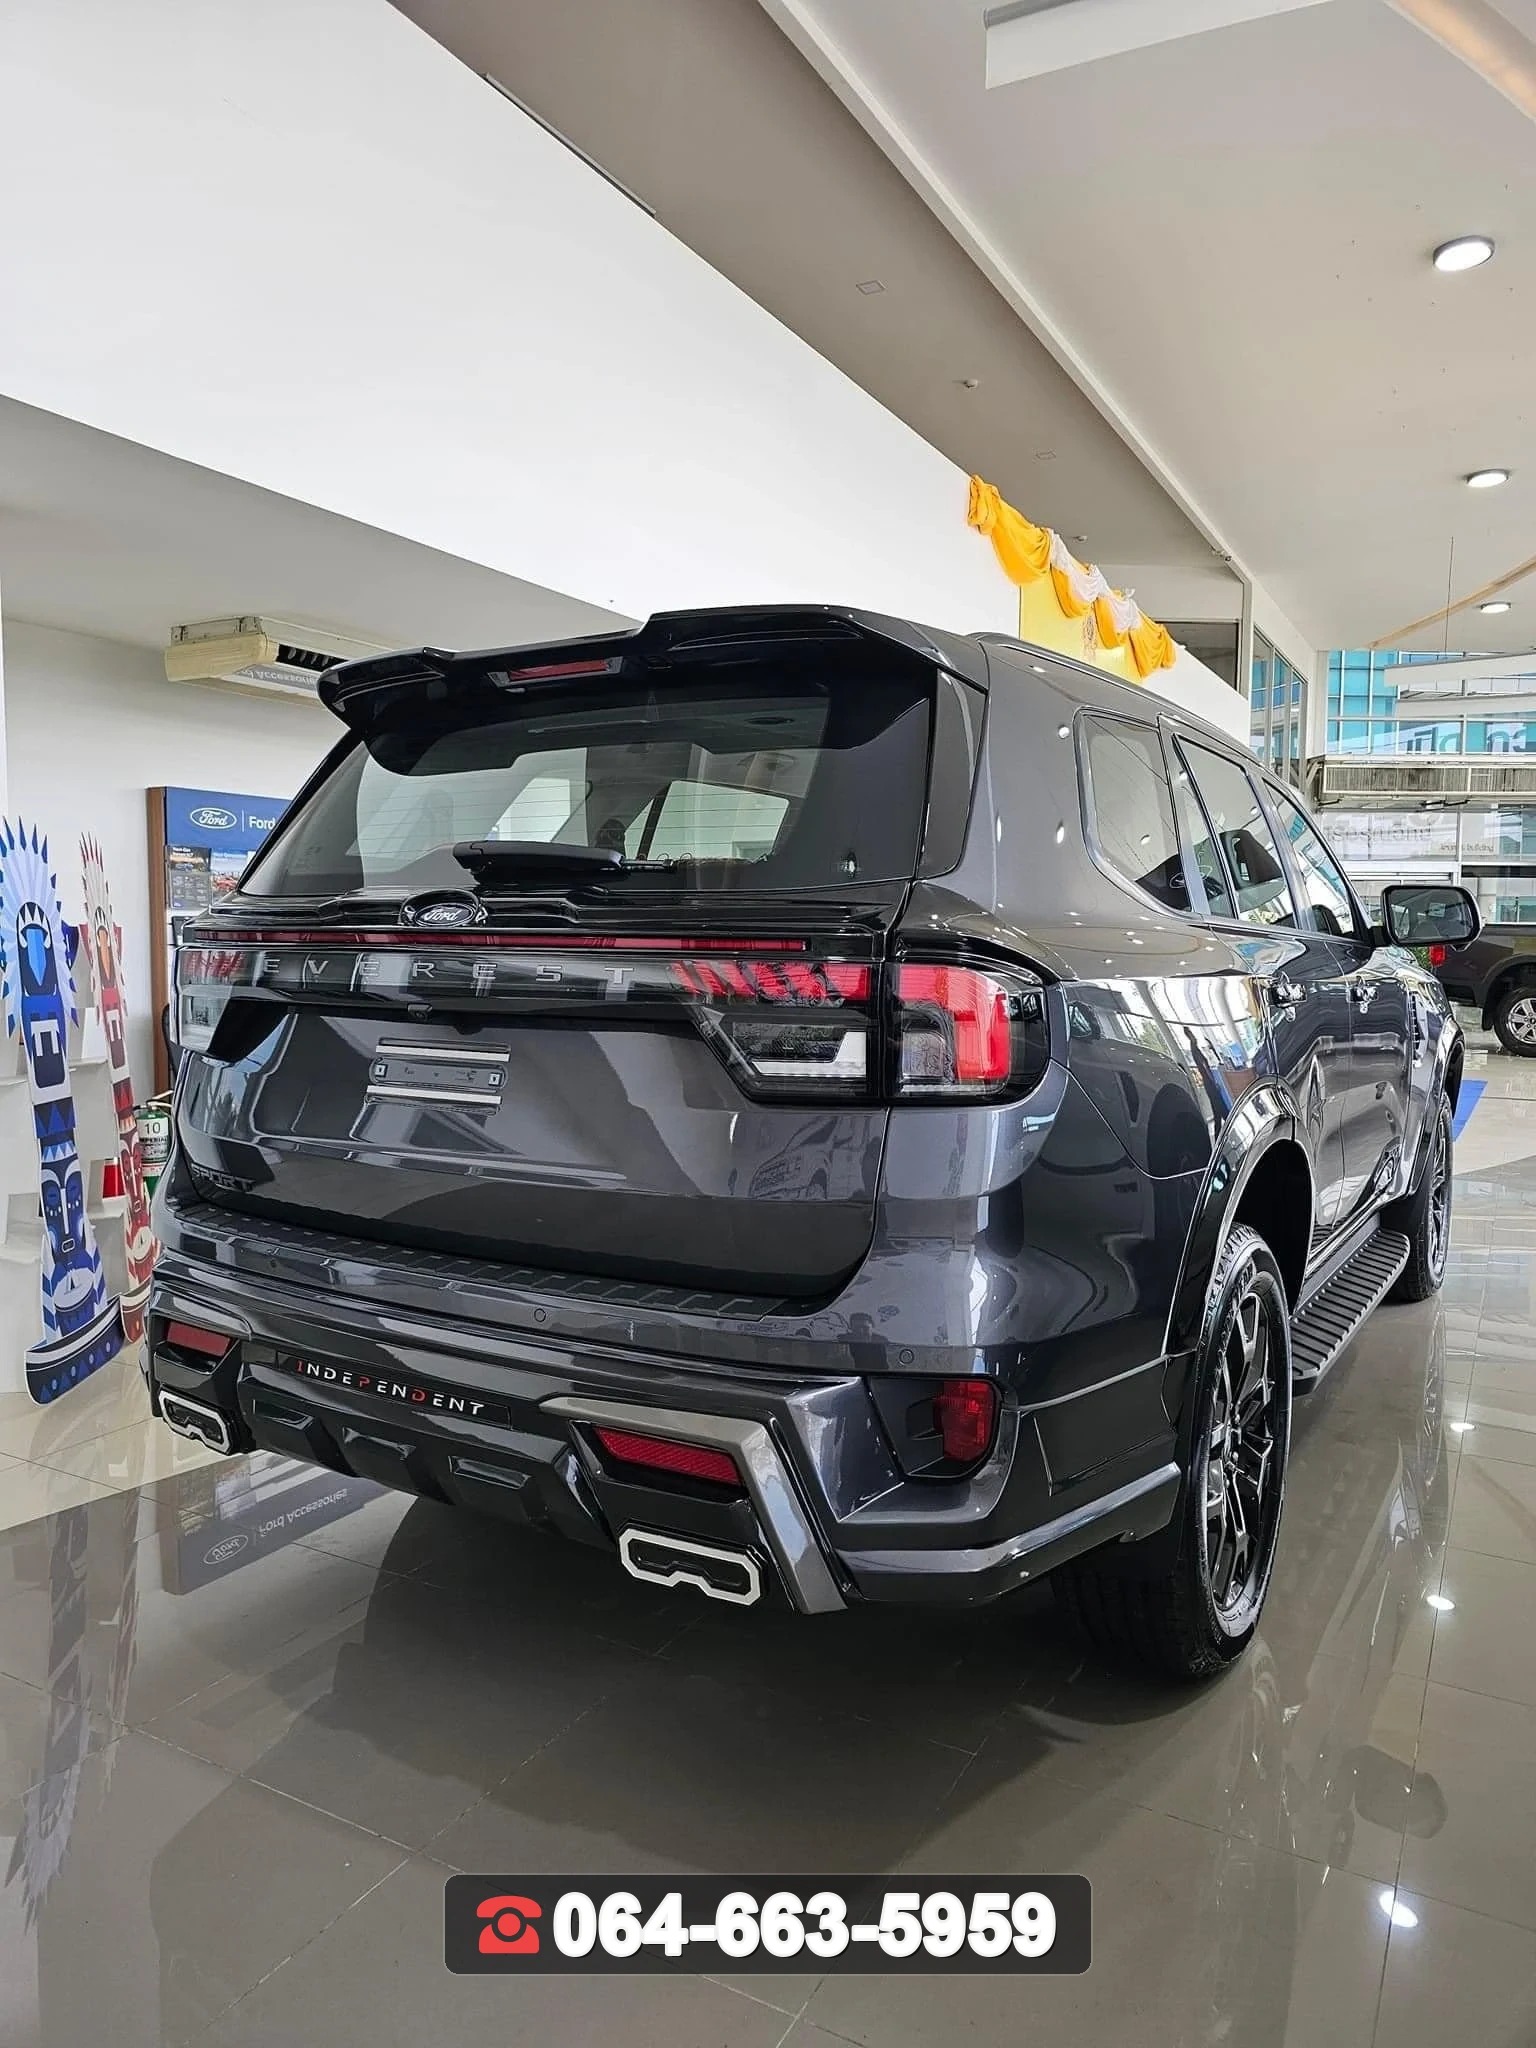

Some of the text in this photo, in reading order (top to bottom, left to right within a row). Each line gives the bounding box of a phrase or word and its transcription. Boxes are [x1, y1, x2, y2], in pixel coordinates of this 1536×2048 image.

[199, 809, 228, 826] Ford
[249, 815, 276, 830] Ford
[423, 905, 463, 921] Ford
[264, 958, 634, 985] EVEREST
[144, 1121, 161, 1135] 10
[191, 1162, 257, 1192] SPORT
[297, 1360, 485, 1415] INDEPENDENT
